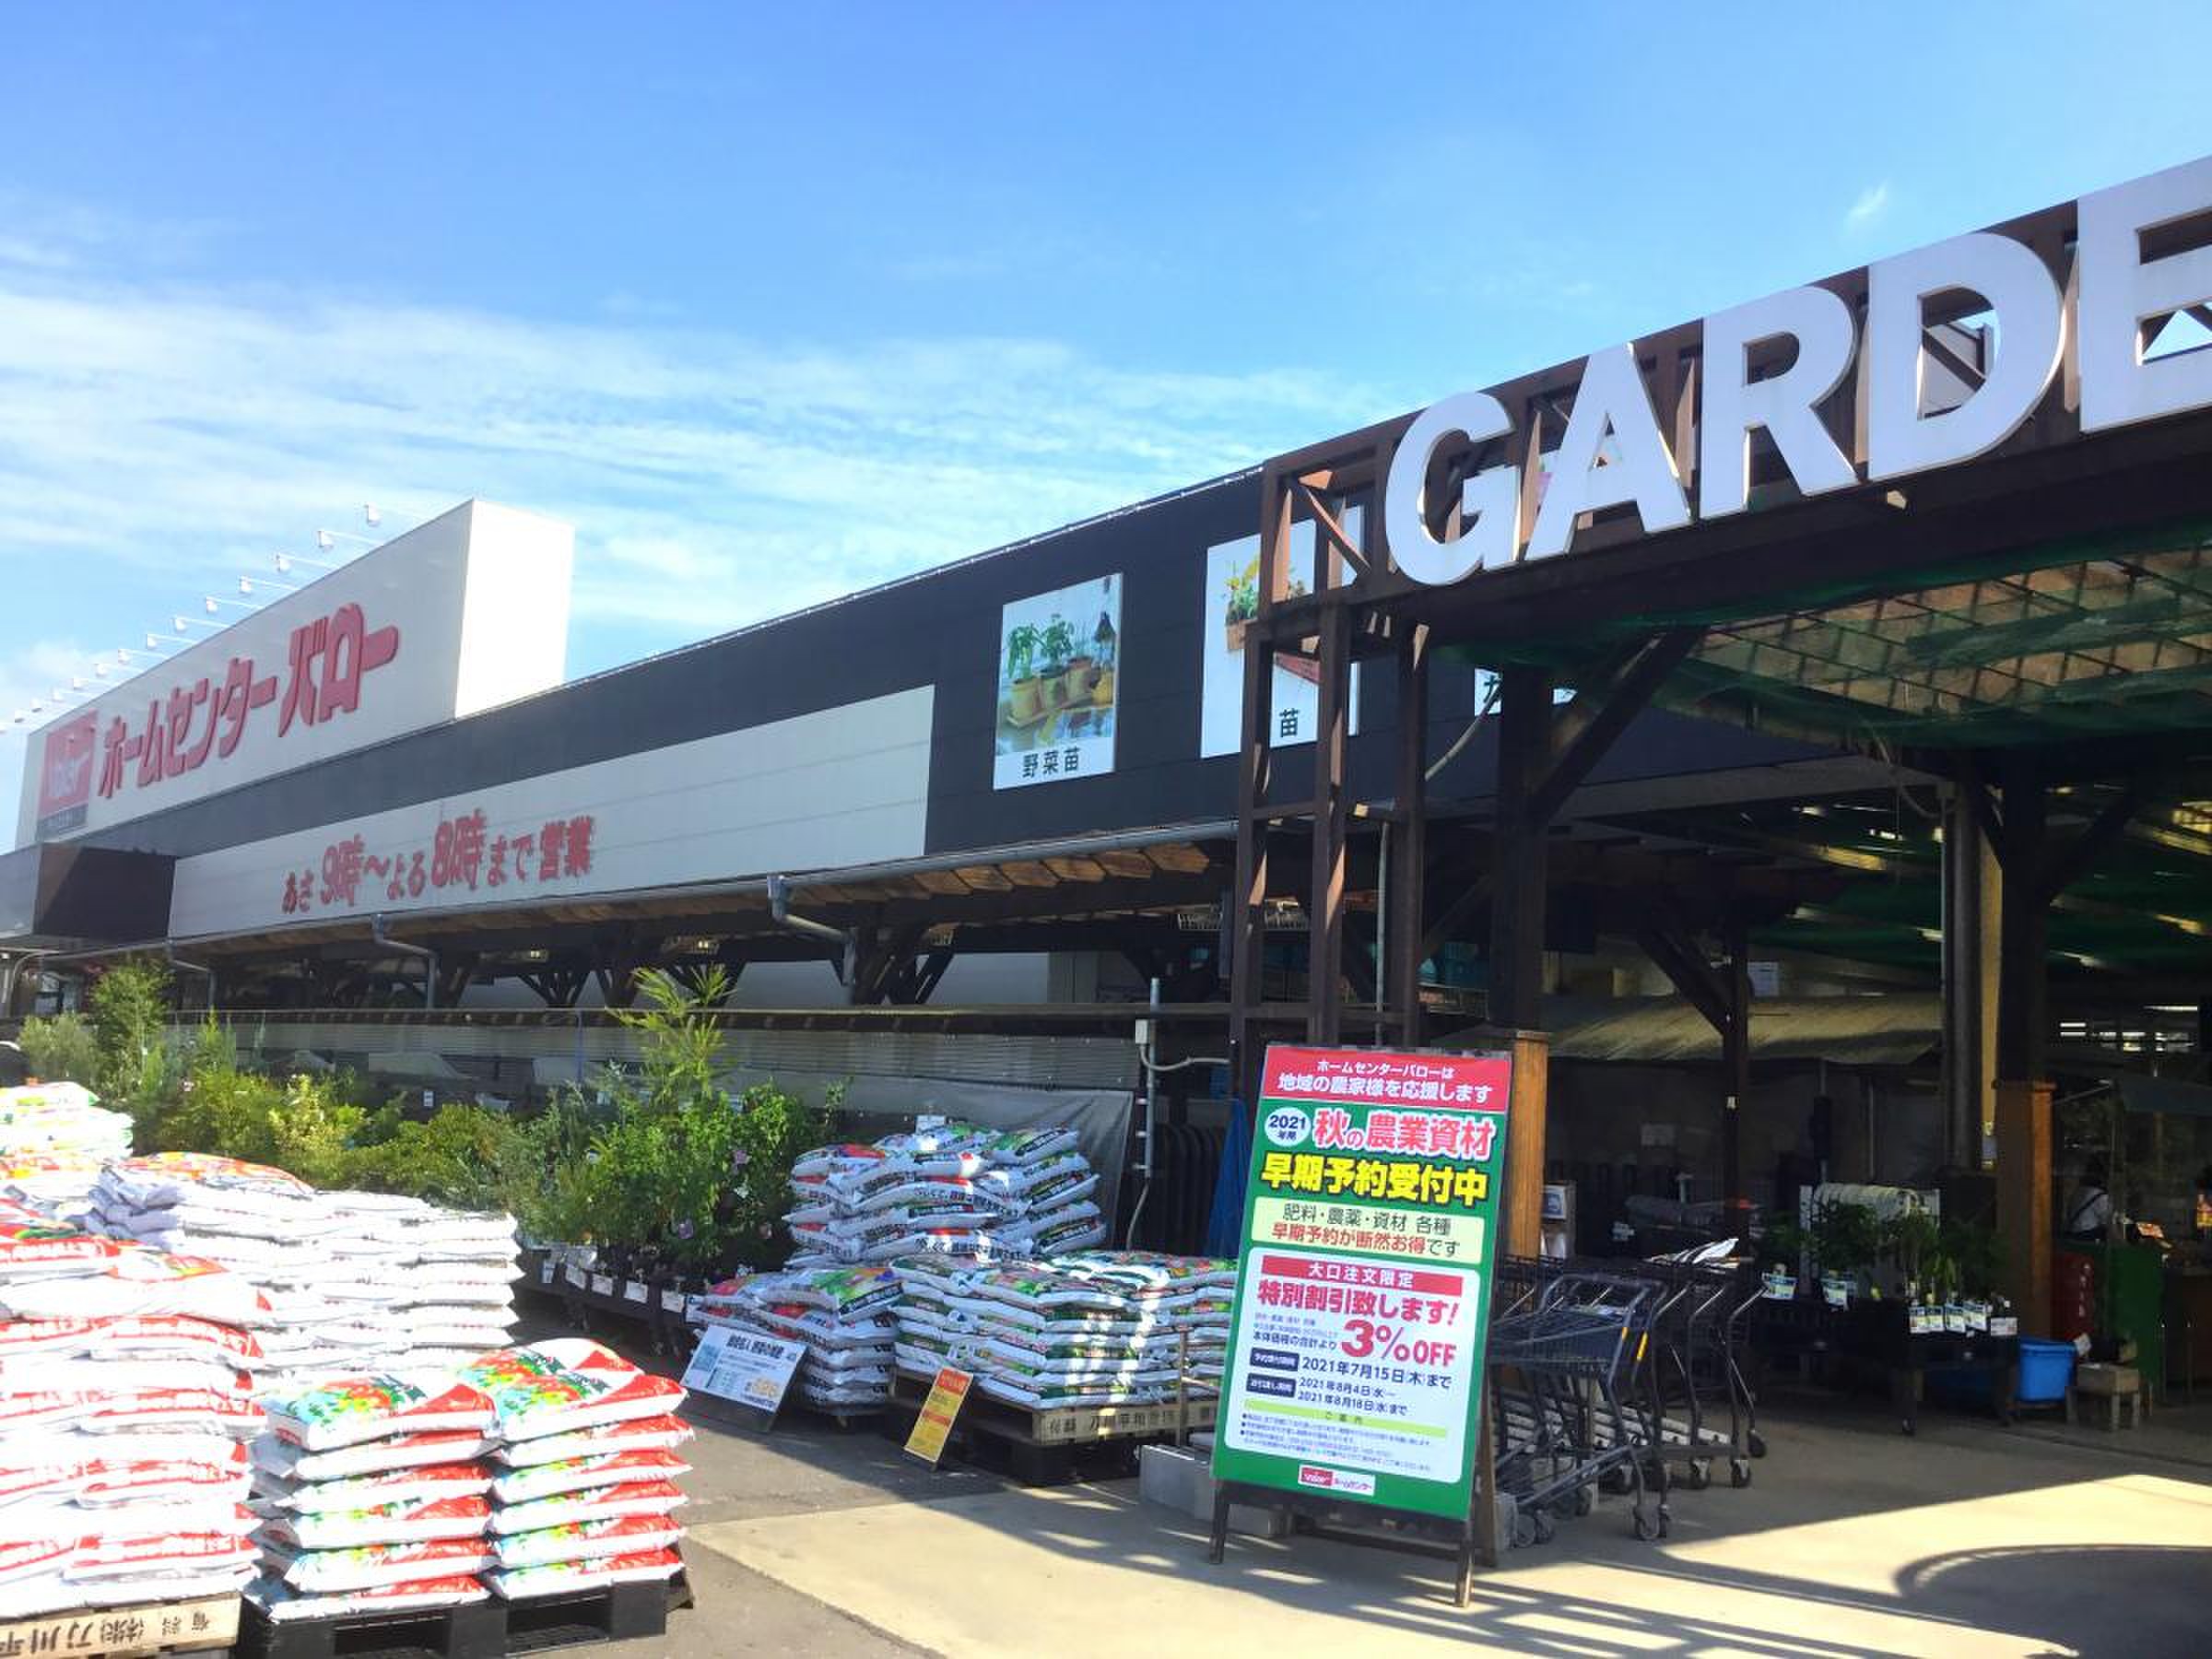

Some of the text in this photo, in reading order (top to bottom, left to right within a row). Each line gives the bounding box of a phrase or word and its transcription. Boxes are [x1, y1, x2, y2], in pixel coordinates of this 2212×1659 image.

[1385, 155, 2212, 586] GARDE
[97, 603, 399, 798] ホームセンターバロー
[1021, 746, 1080, 778] 野菜苗
[1317, 1060, 1454, 1080] ホームセンターバローは
[1277, 1073, 1492, 1103] 地域の農家様を応援します
[1268, 1114, 1306, 1130] 2021
[1313, 1109, 1493, 1158] 秋の農業資材
[1262, 1153, 1488, 1206] 早期予約受付中
[1283, 1203, 1451, 1236] 肥料・農薬・資材 各種
[1271, 1222, 1460, 1258] 早期予約が断然お得です
[1308, 1264, 1414, 1287] 大口注文限定
